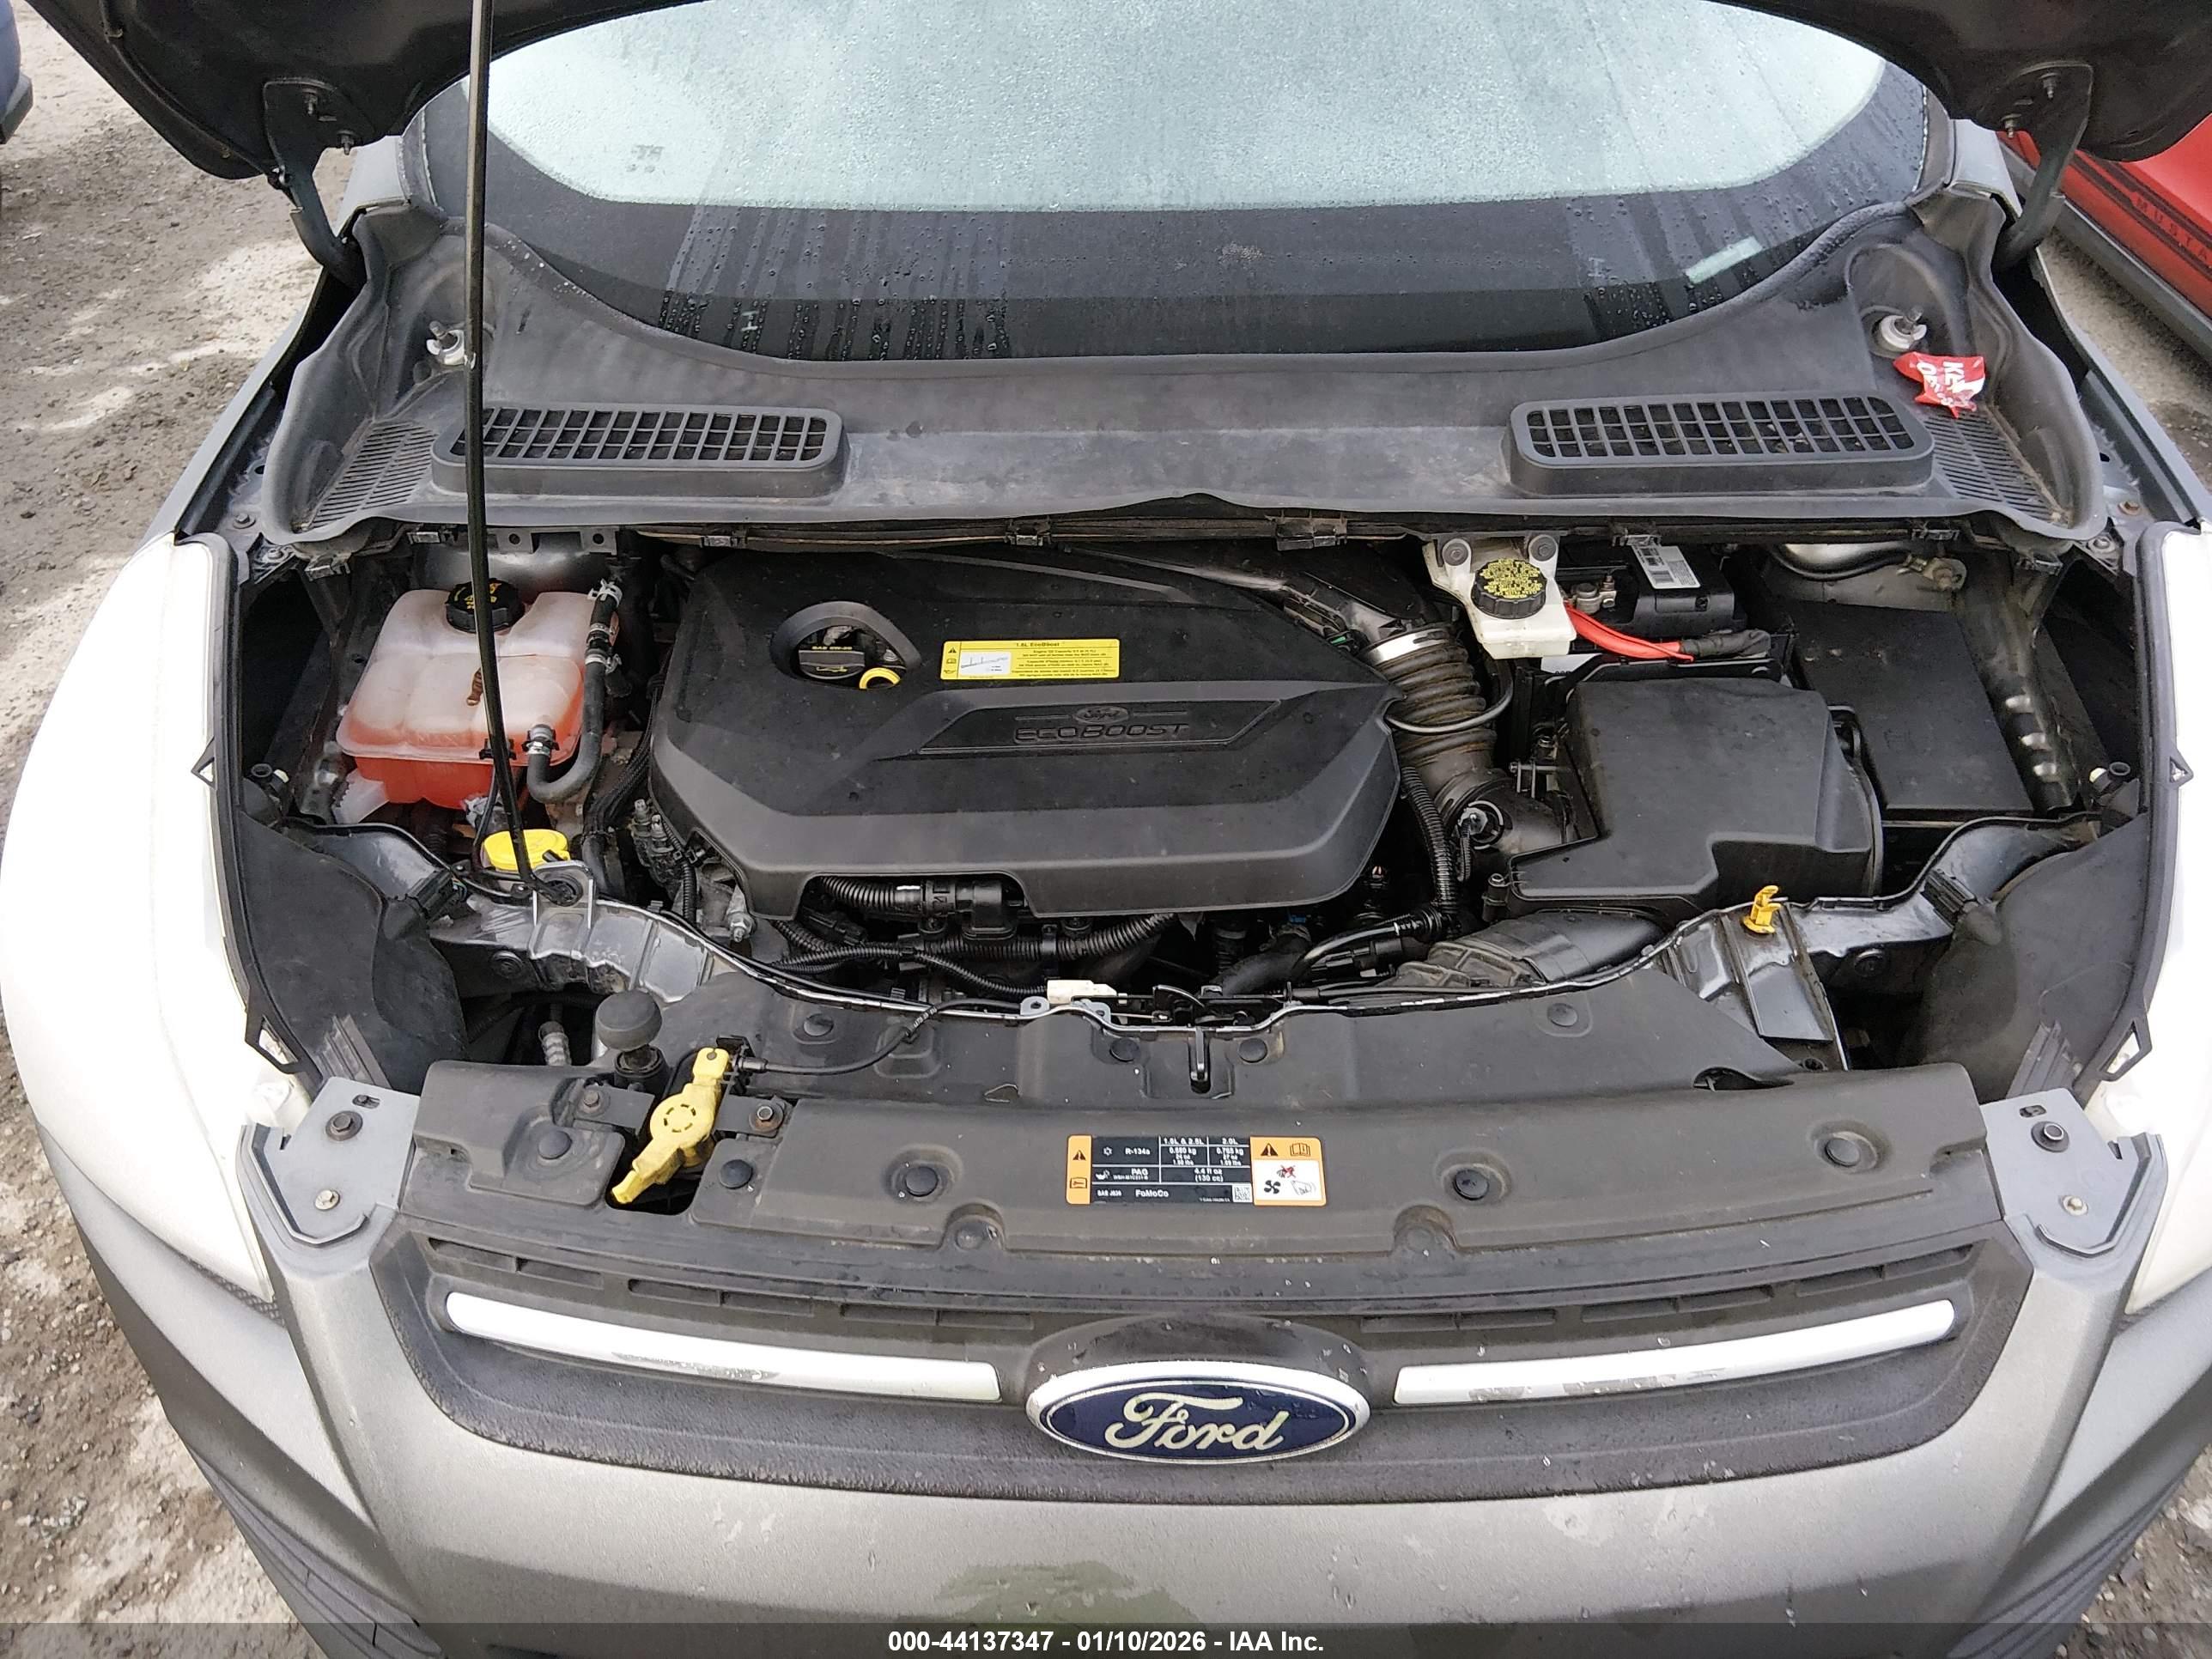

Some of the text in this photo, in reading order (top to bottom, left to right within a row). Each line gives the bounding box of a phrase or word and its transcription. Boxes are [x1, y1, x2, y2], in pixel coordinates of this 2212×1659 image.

[1014, 724, 1191, 743] ECOBOOST
[1188, 1147, 1197, 1156] kg
[1236, 1147, 1244, 1156] kg
[1135, 1188, 1170, 1198] FoMoCo
[1104, 1390, 1291, 1452] Ford
